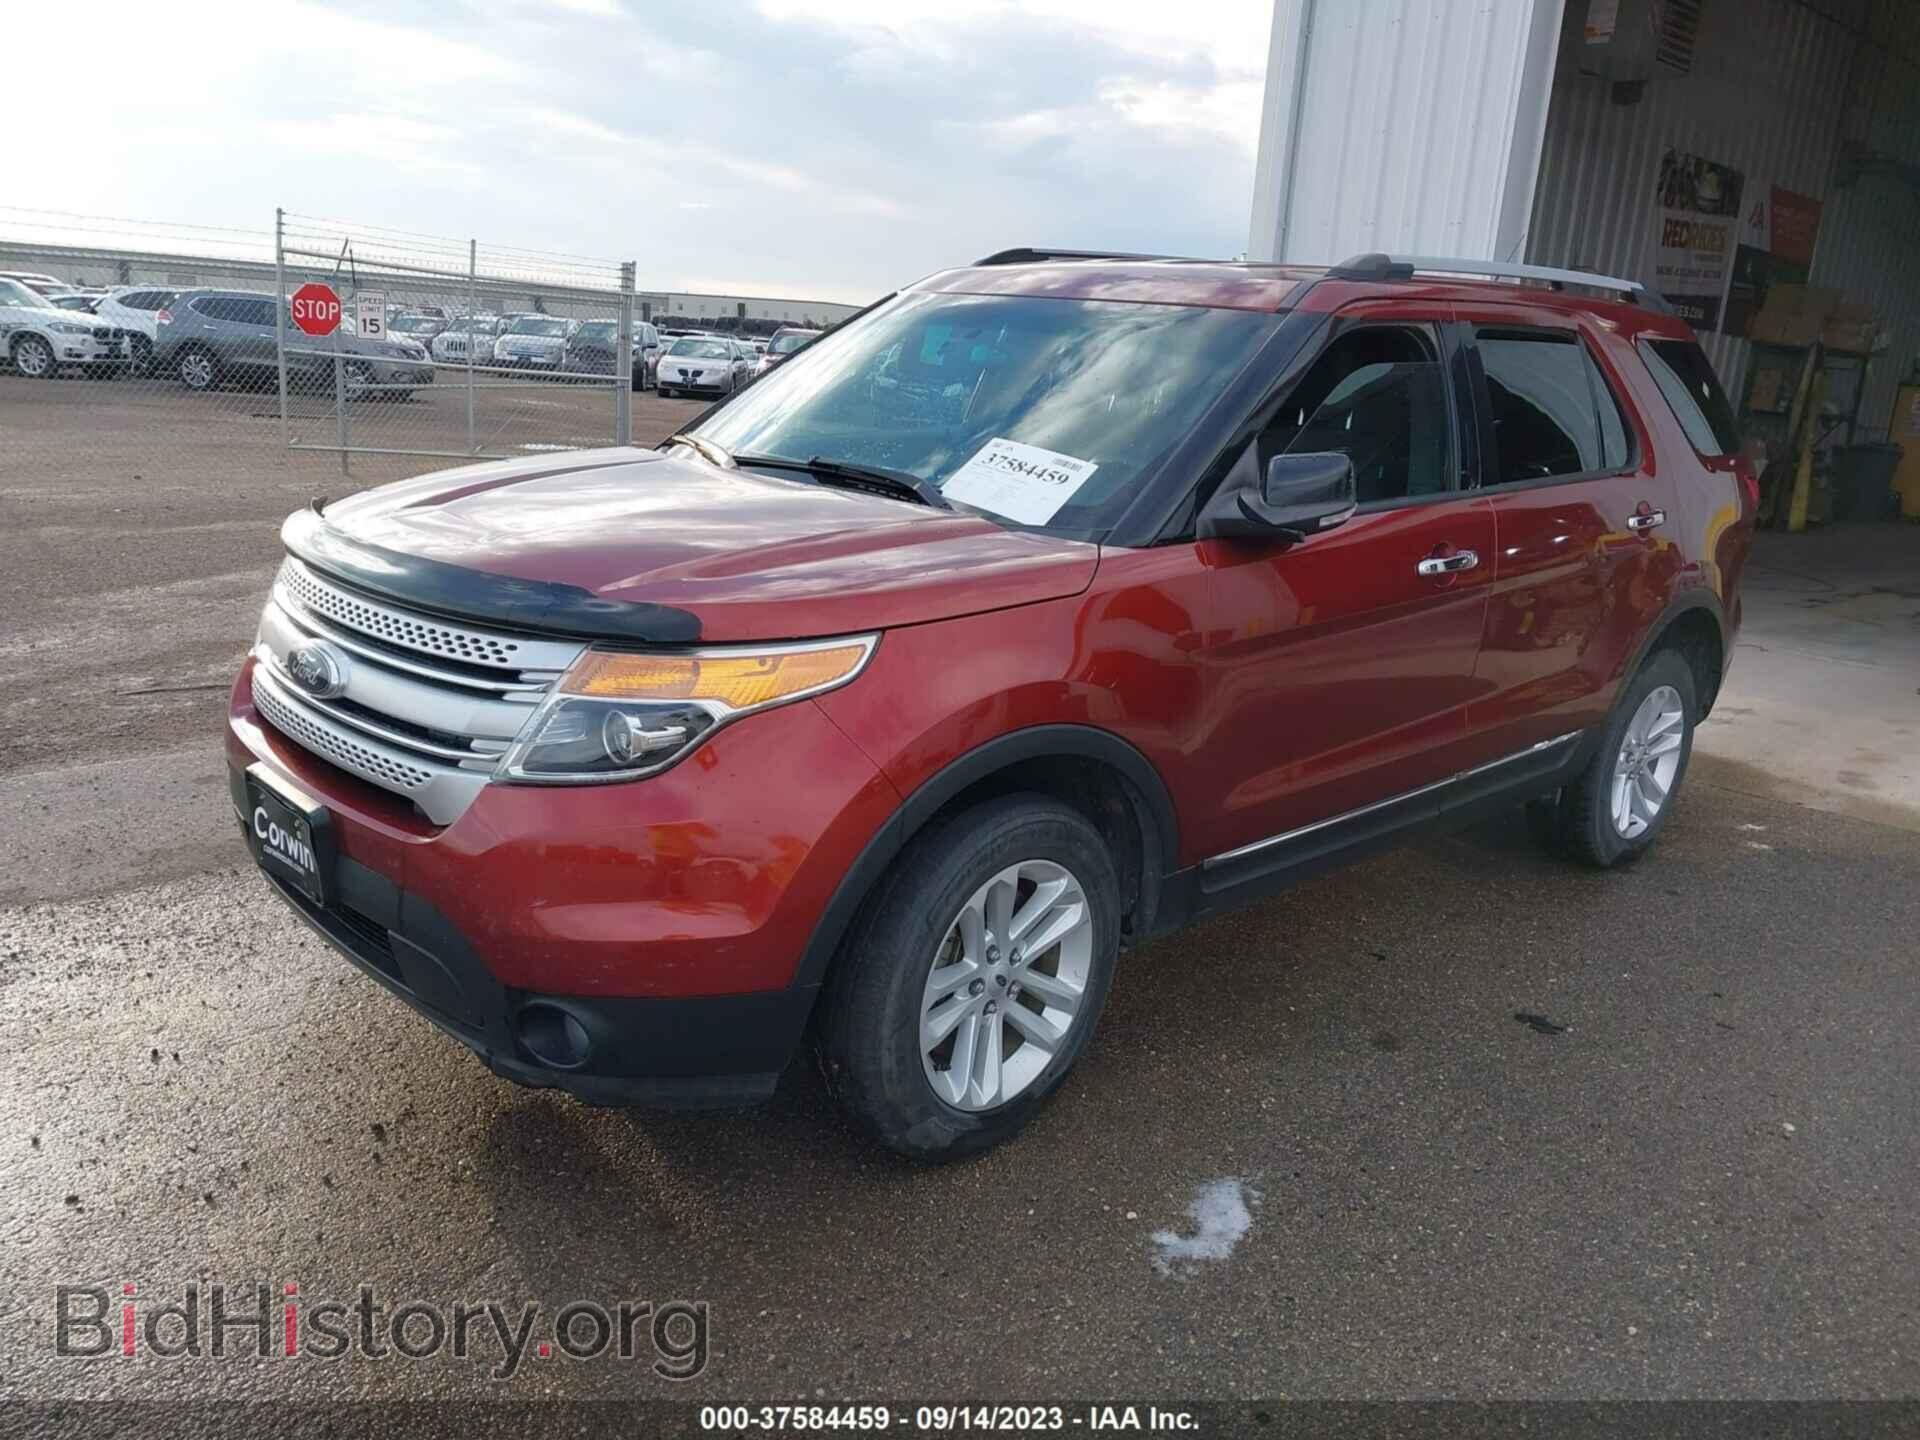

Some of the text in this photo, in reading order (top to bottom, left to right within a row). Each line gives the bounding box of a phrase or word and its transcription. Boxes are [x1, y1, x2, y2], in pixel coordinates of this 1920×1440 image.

[294, 299, 340, 321] STOP
[358, 295, 384, 305] SPEED
[360, 305, 381, 313] LIMIT
[361, 318, 381, 334] 15
[982, 453, 1070, 485] 37584459
[291, 649, 322, 686] Ford
[254, 806, 314, 873] Corwin
